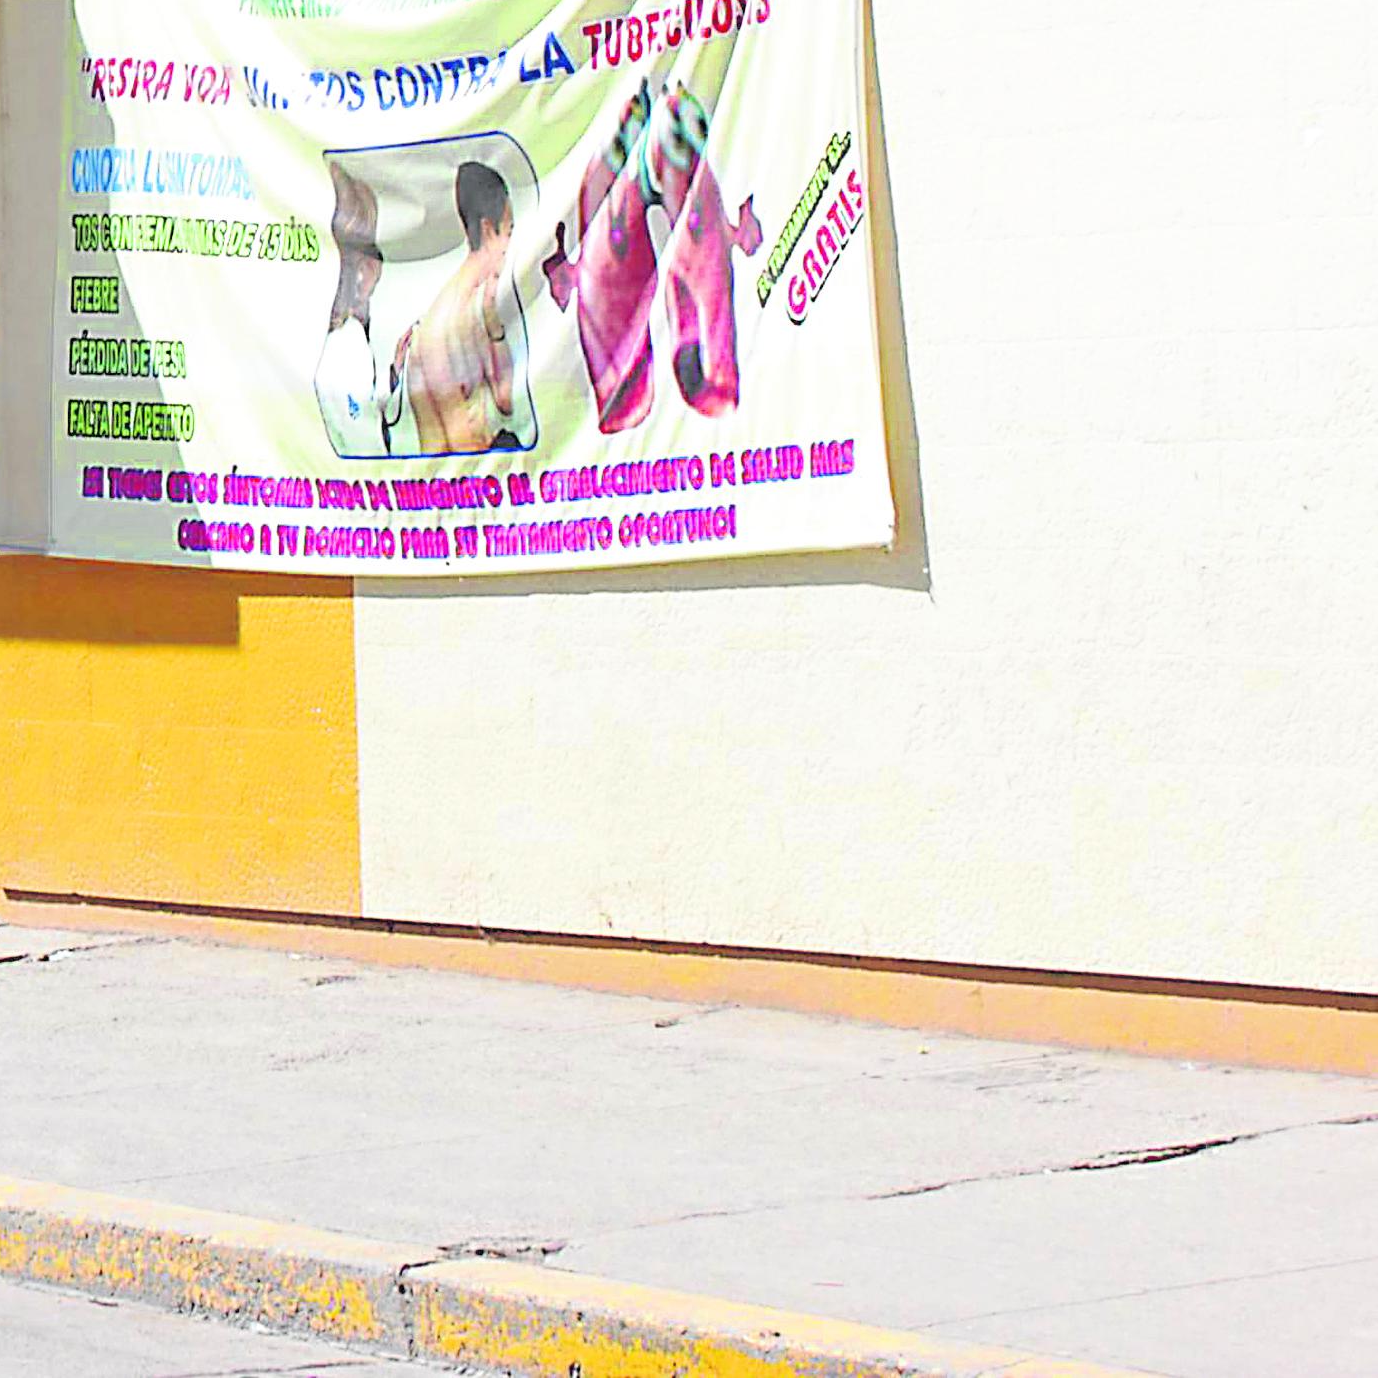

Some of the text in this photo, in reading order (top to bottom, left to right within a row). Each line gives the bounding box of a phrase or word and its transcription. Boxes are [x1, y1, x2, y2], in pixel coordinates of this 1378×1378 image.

[519, 31, 575, 83] LA
[72, 214, 100, 253] TOS
[101, 214, 133, 253] CON
[227, 220, 258, 259] DE
[787, 168, 864, 325] GRATIS
[71, 275, 120, 314] FIEBRE
[69, 329, 129, 376] PÉRDIDA
[130, 339, 151, 377] DE
[68, 399, 111, 439] FALTA
[111, 401, 132, 440] DE
[709, 451, 737, 488] DE
[741, 444, 804, 485] SALUD
